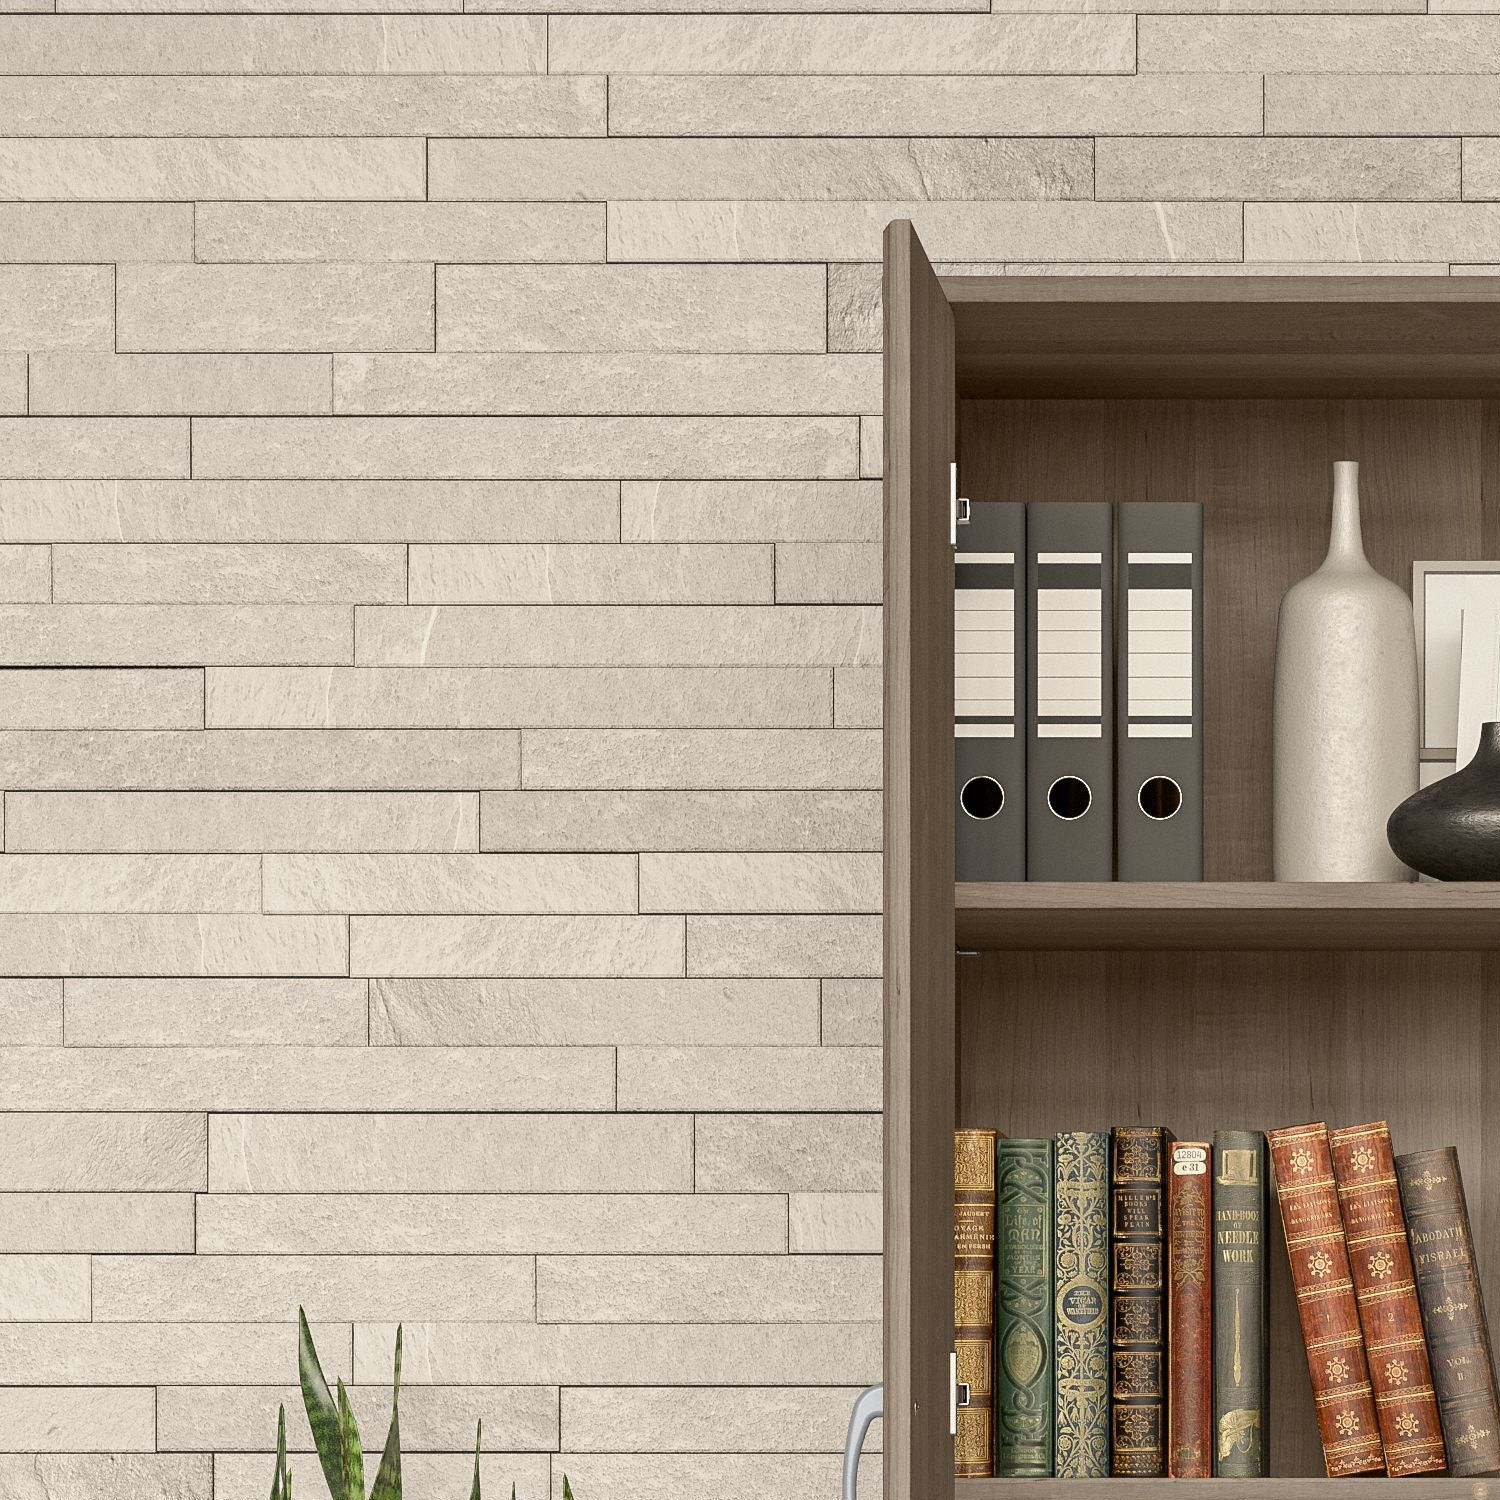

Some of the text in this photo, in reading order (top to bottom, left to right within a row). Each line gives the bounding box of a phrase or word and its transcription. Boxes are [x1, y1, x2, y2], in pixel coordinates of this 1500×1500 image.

[1176, 1150, 1202, 1160] 12804
[1189, 1162, 1199, 1172] 31
[1033, 1215, 1043, 1228] of
[1217, 1230, 1259, 1244] NEEDLE
[1222, 1249, 1254, 1263] WORK
[1387, 1312, 1395, 1322] 2
